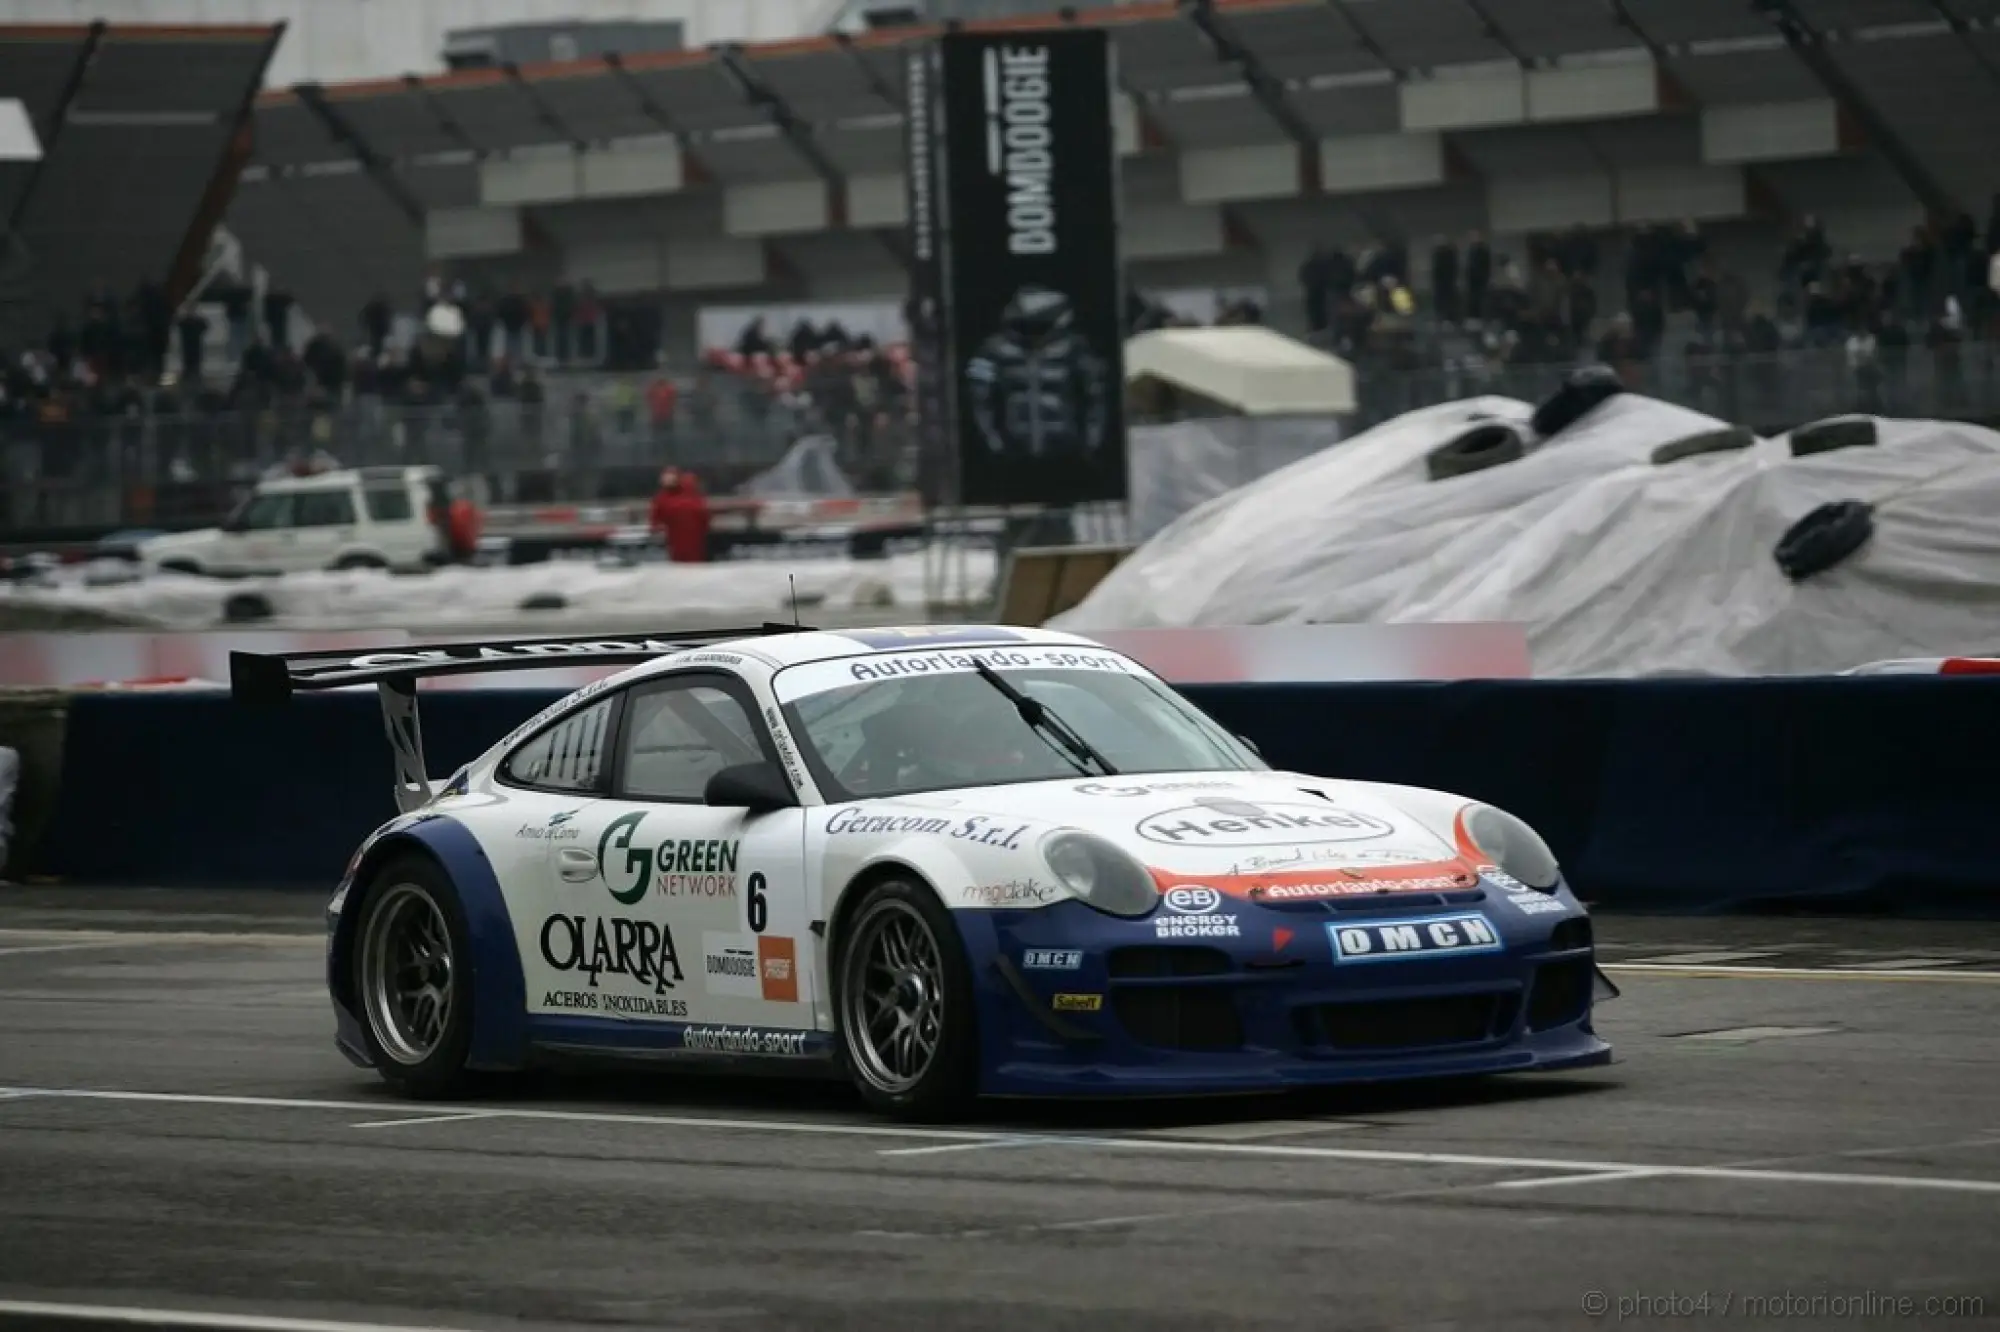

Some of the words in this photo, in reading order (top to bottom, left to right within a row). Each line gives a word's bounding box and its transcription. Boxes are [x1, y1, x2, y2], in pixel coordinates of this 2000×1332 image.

[850, 651, 1129, 681] Autorlando-sport
[826, 807, 951, 835] Geracom
[951, 815, 1029, 850] S.r.l.
[1148, 811, 1381, 841] Henkel
[657, 839, 740, 873] GREEN
[656, 874, 738, 897] NETWORK
[748, 871, 767, 932] 6
[1340, 919, 1493, 955] OMCN
[541, 913, 684, 994] OLARRA
[1025, 951, 1080, 967] OMCN
[543, 990, 598, 1009] ACEROS
[600, 993, 688, 1016] INOXIDABLES
[683, 1025, 806, 1054] Autorlando-sport
